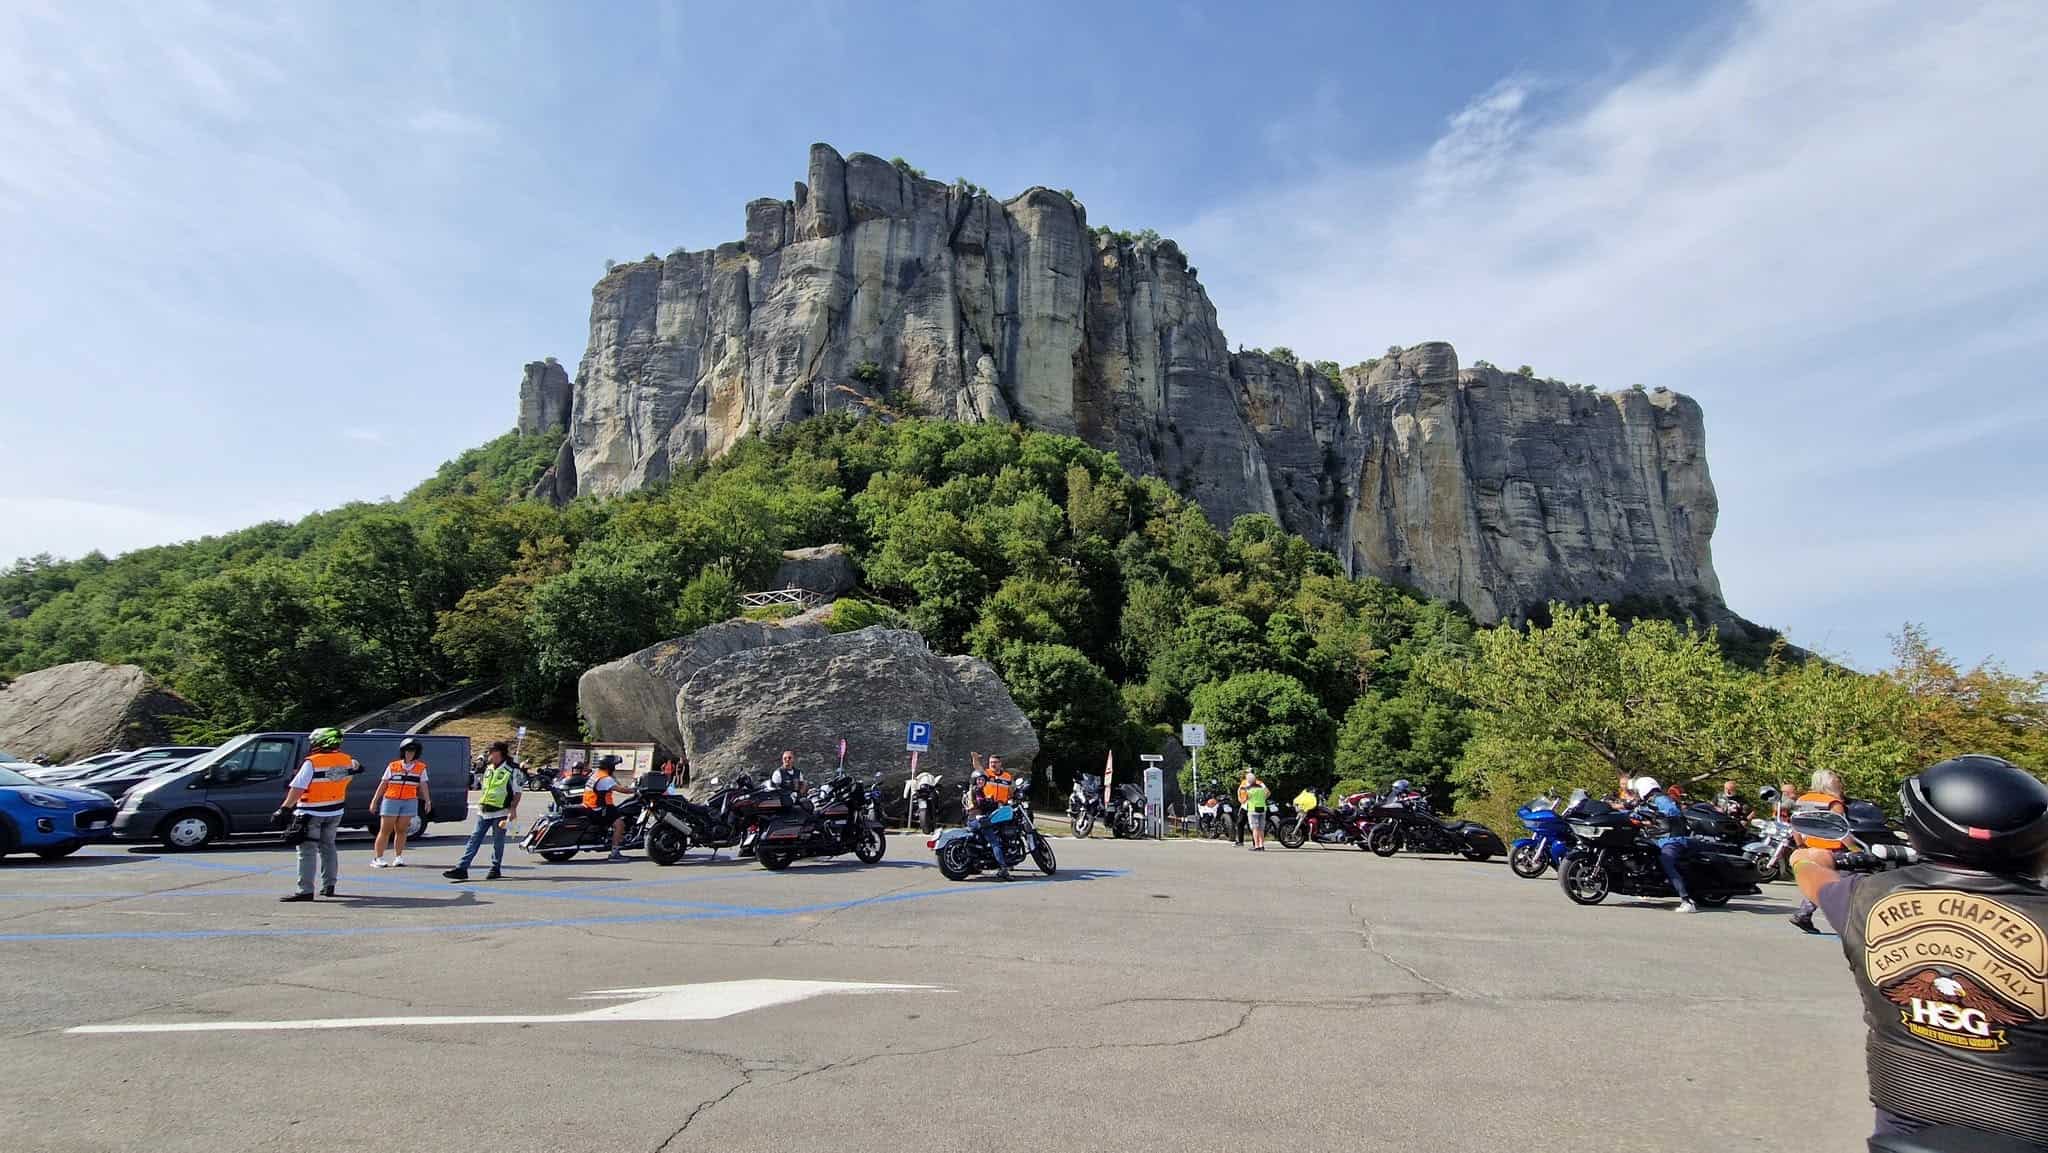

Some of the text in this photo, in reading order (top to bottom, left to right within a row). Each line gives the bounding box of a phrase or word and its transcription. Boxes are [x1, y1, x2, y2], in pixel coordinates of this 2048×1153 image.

[912, 725, 926, 741] P
[1878, 898, 2034, 949] FREE CHAPTER
[1875, 943, 2034, 998] EAST COAST ITALY
[1911, 997, 1991, 1036] HOG
